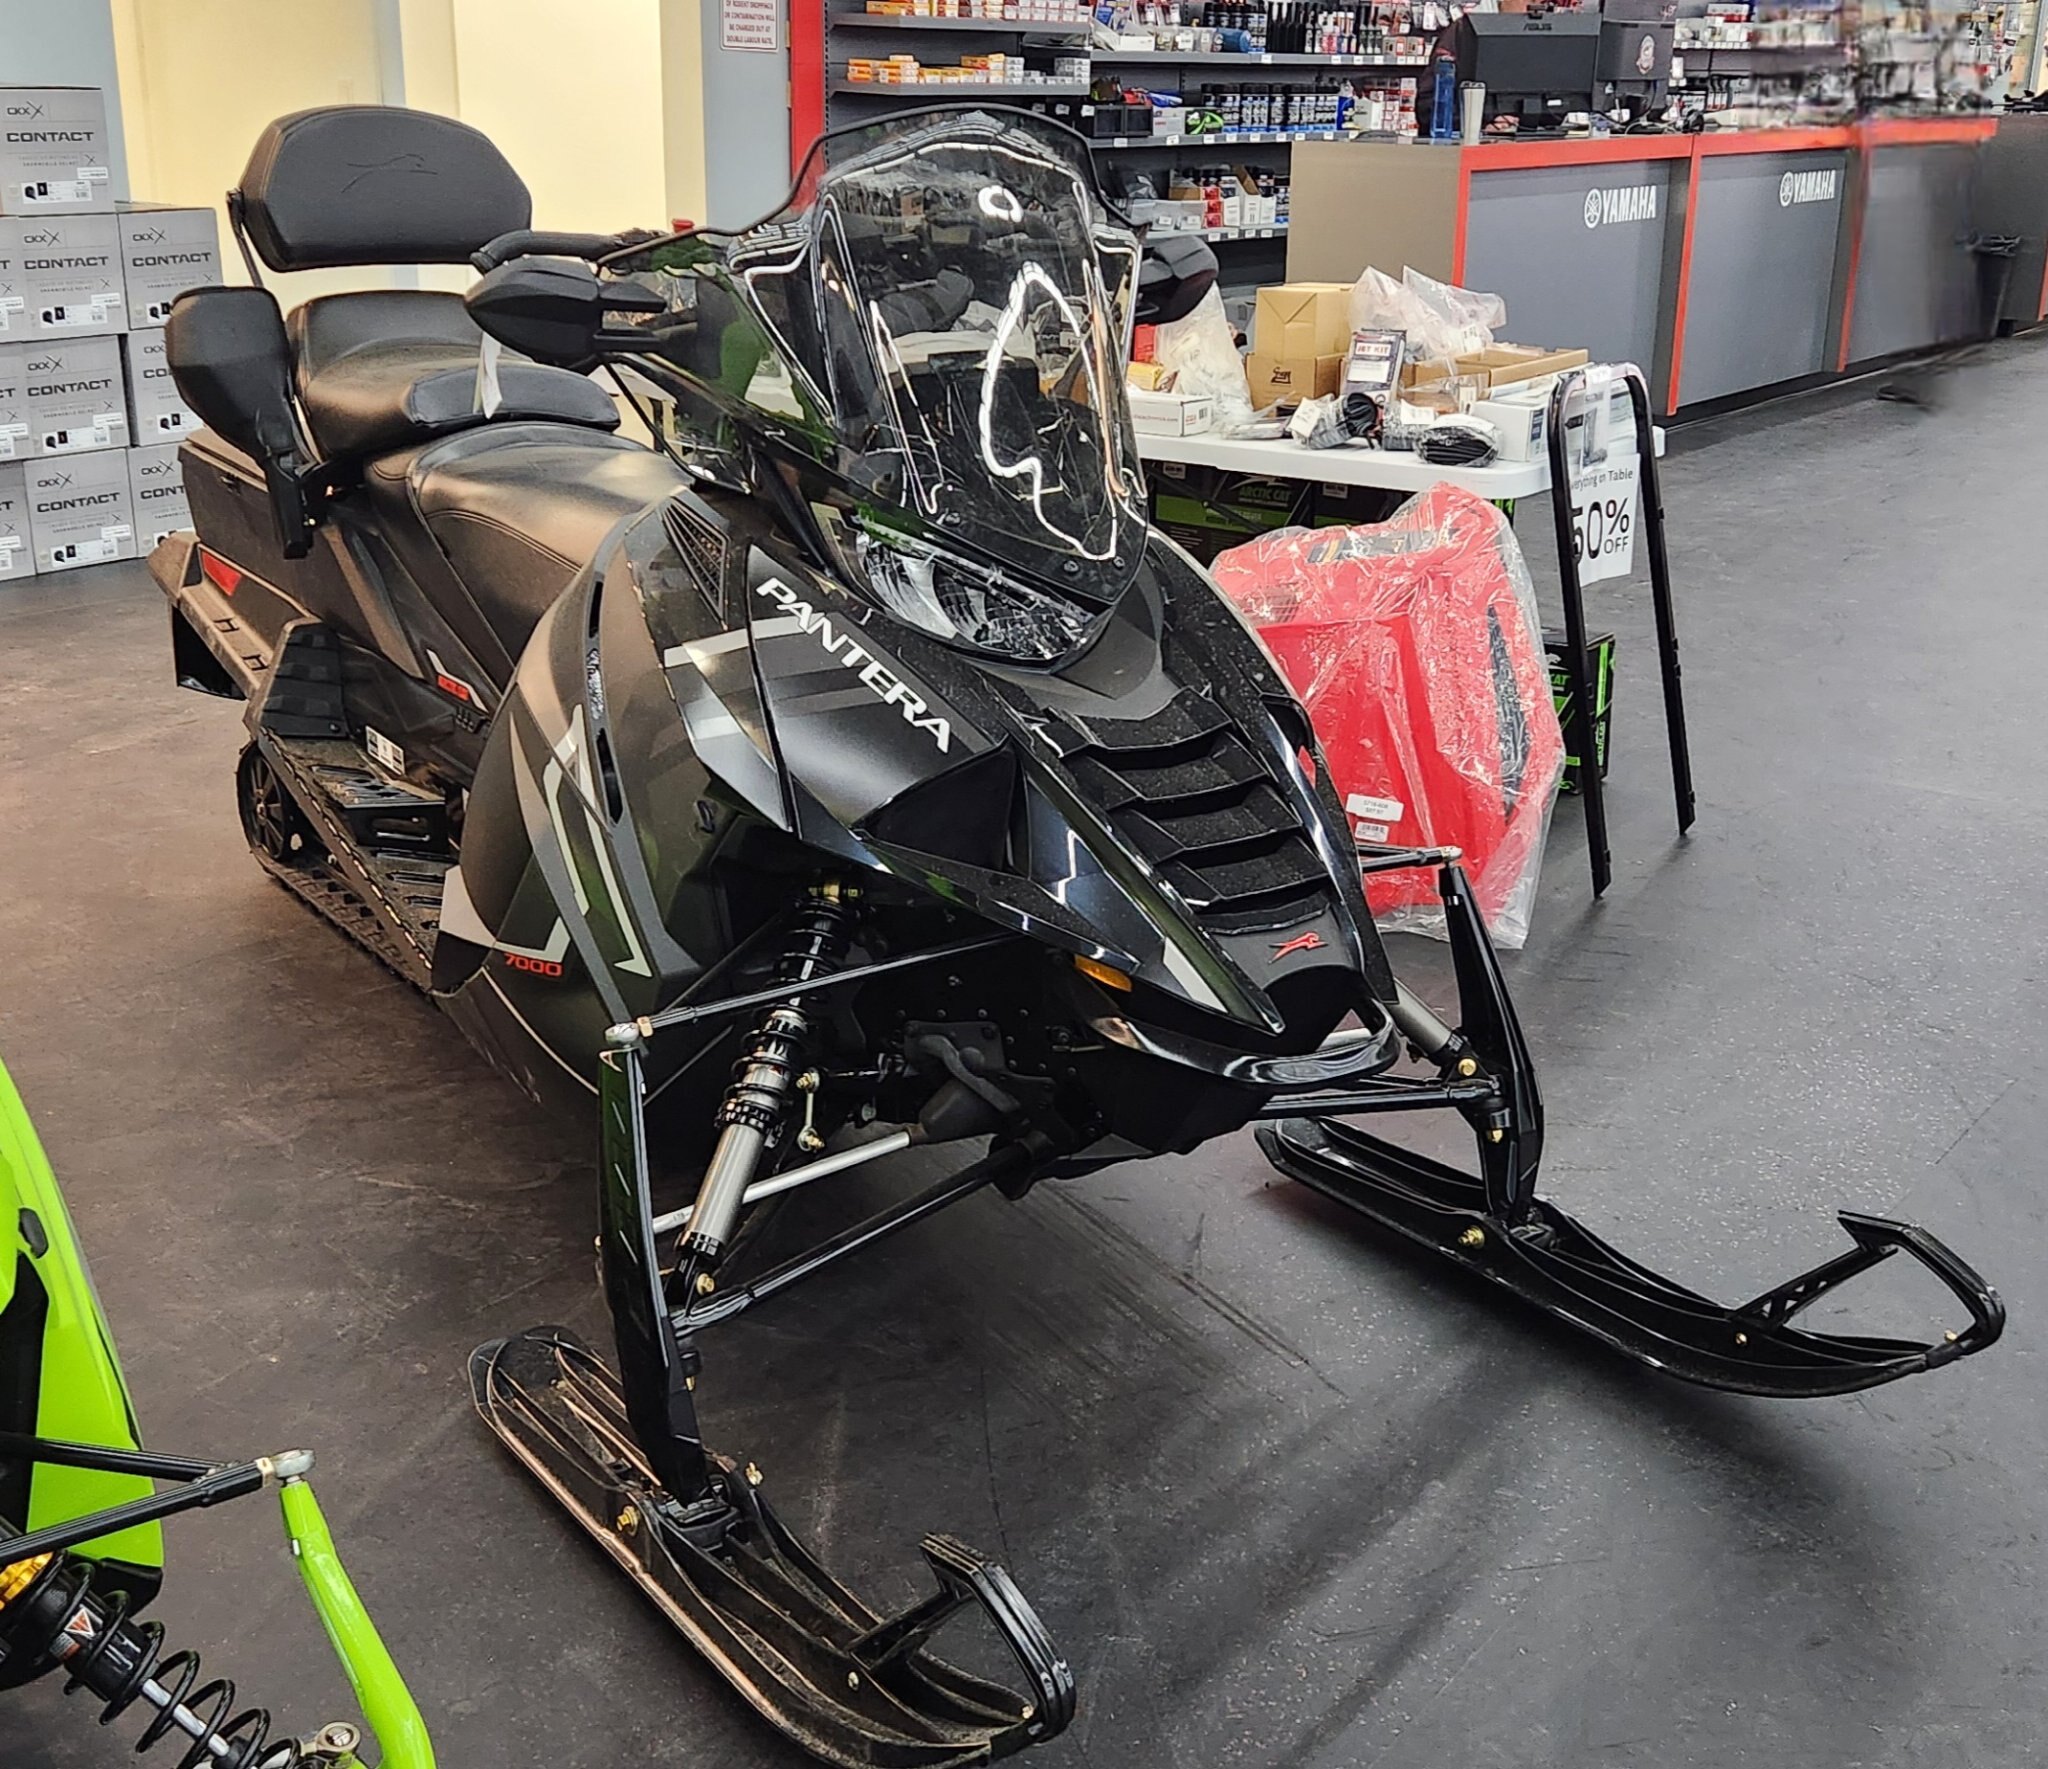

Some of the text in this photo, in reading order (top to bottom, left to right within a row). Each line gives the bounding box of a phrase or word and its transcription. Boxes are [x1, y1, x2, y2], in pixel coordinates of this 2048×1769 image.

[6, 132, 94, 142] CONTACT
[1793, 169, 1837, 204] YAMAHA
[1602, 185, 1657, 225] YAMAHA
[24, 256, 109, 270] CONTACT
[132, 252, 212, 267] CONTACT
[1357, 344, 1389, 353] JET KIT
[27, 379, 112, 397] CONTACT
[1608, 468, 1633, 481] Table
[37, 492, 121, 512] CONTACT
[1239, 486, 1292, 501] ARCTIC CAT
[1604, 536, 1629, 554] OFF
[756, 577, 950, 754] PANTERA
[504, 953, 562, 976] 7000
